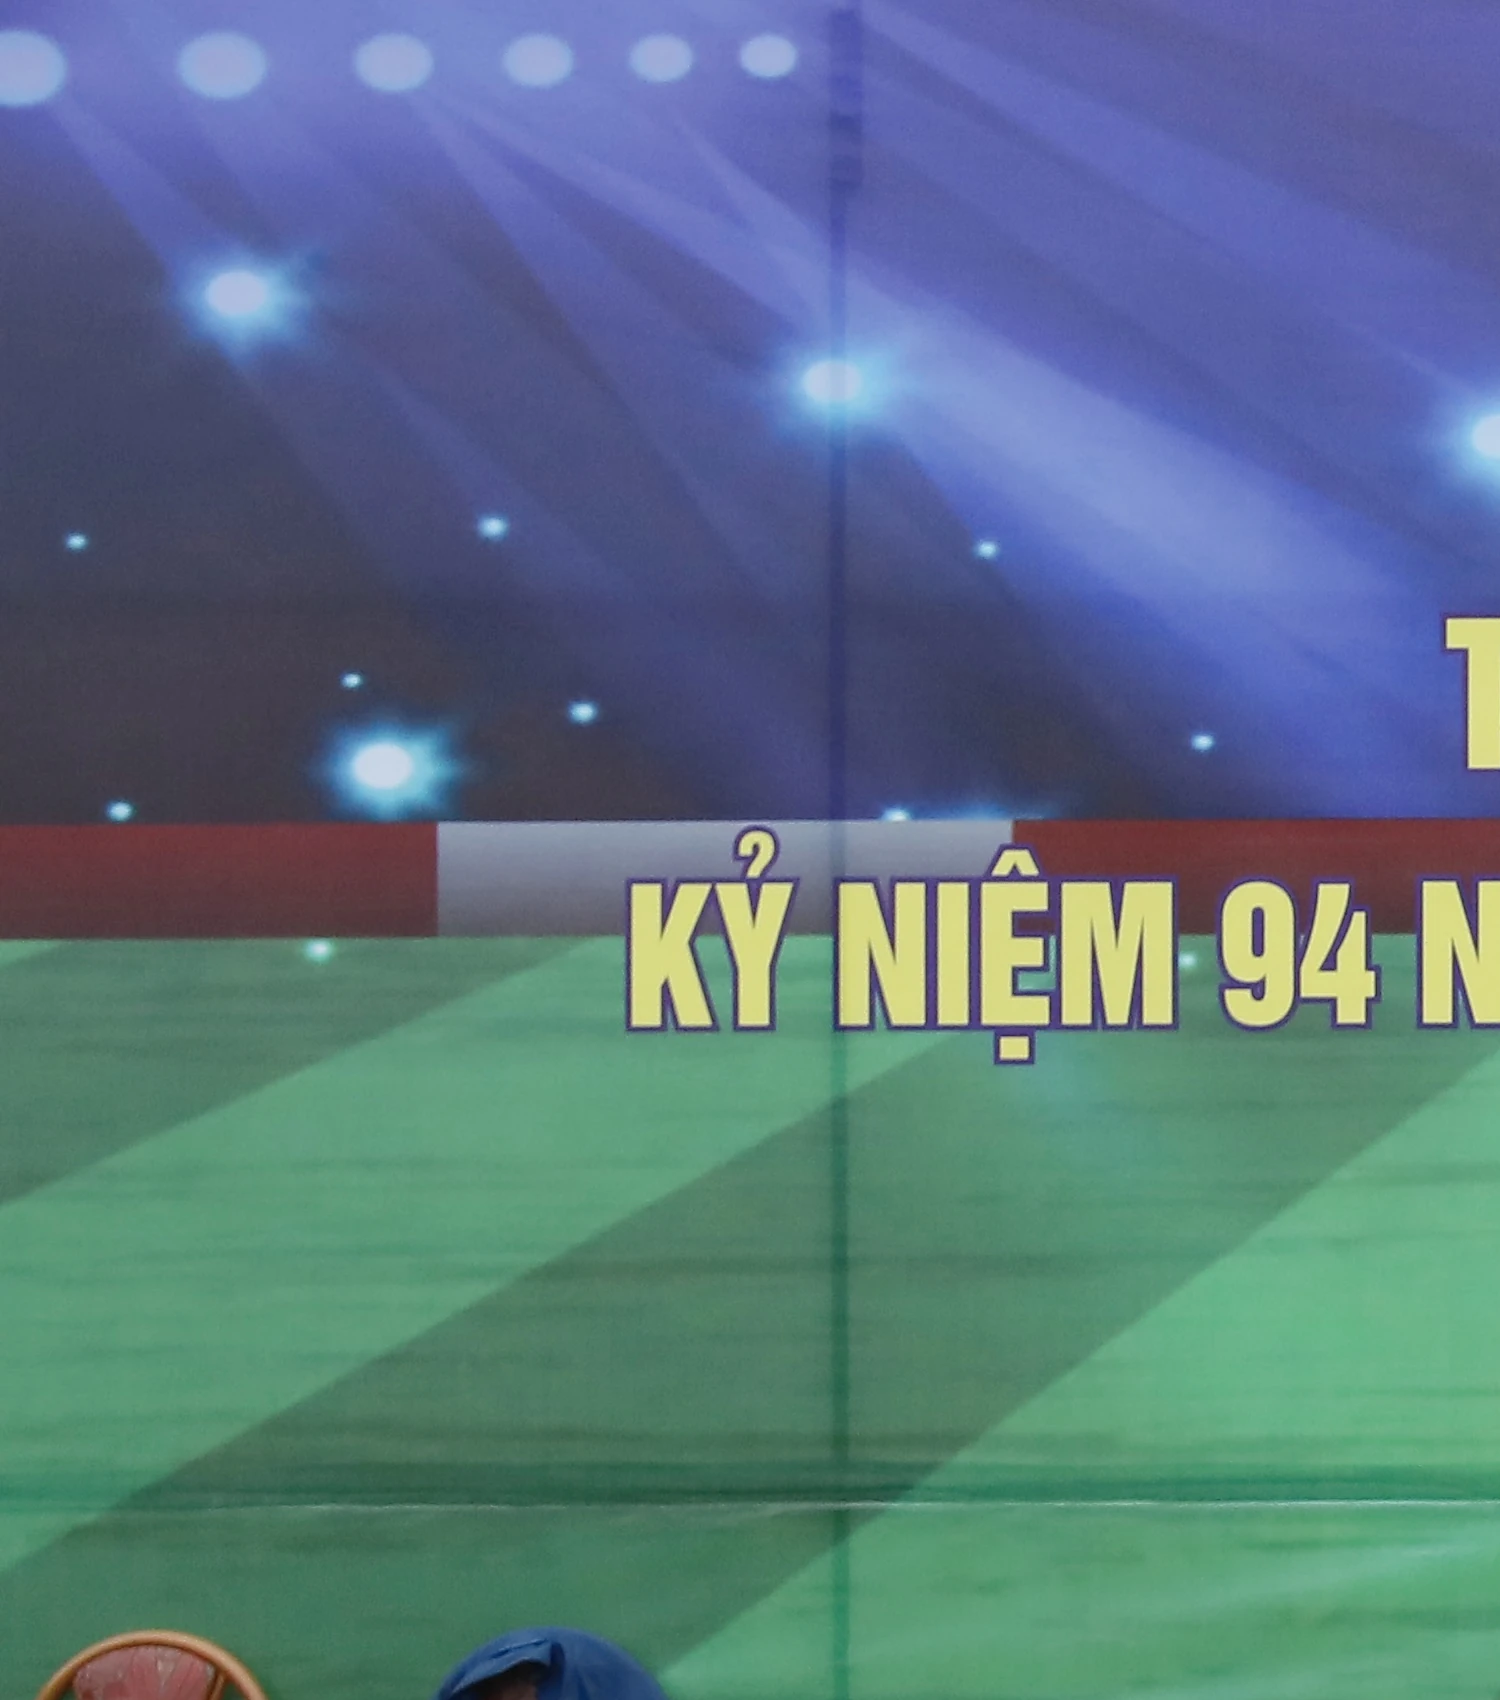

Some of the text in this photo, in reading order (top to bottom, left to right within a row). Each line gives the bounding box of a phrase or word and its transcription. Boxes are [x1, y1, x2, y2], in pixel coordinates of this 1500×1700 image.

[629, 830, 793, 1029] KỶ
[836, 849, 1176, 1061] NIỆM
[1220, 880, 1377, 1028] 94
